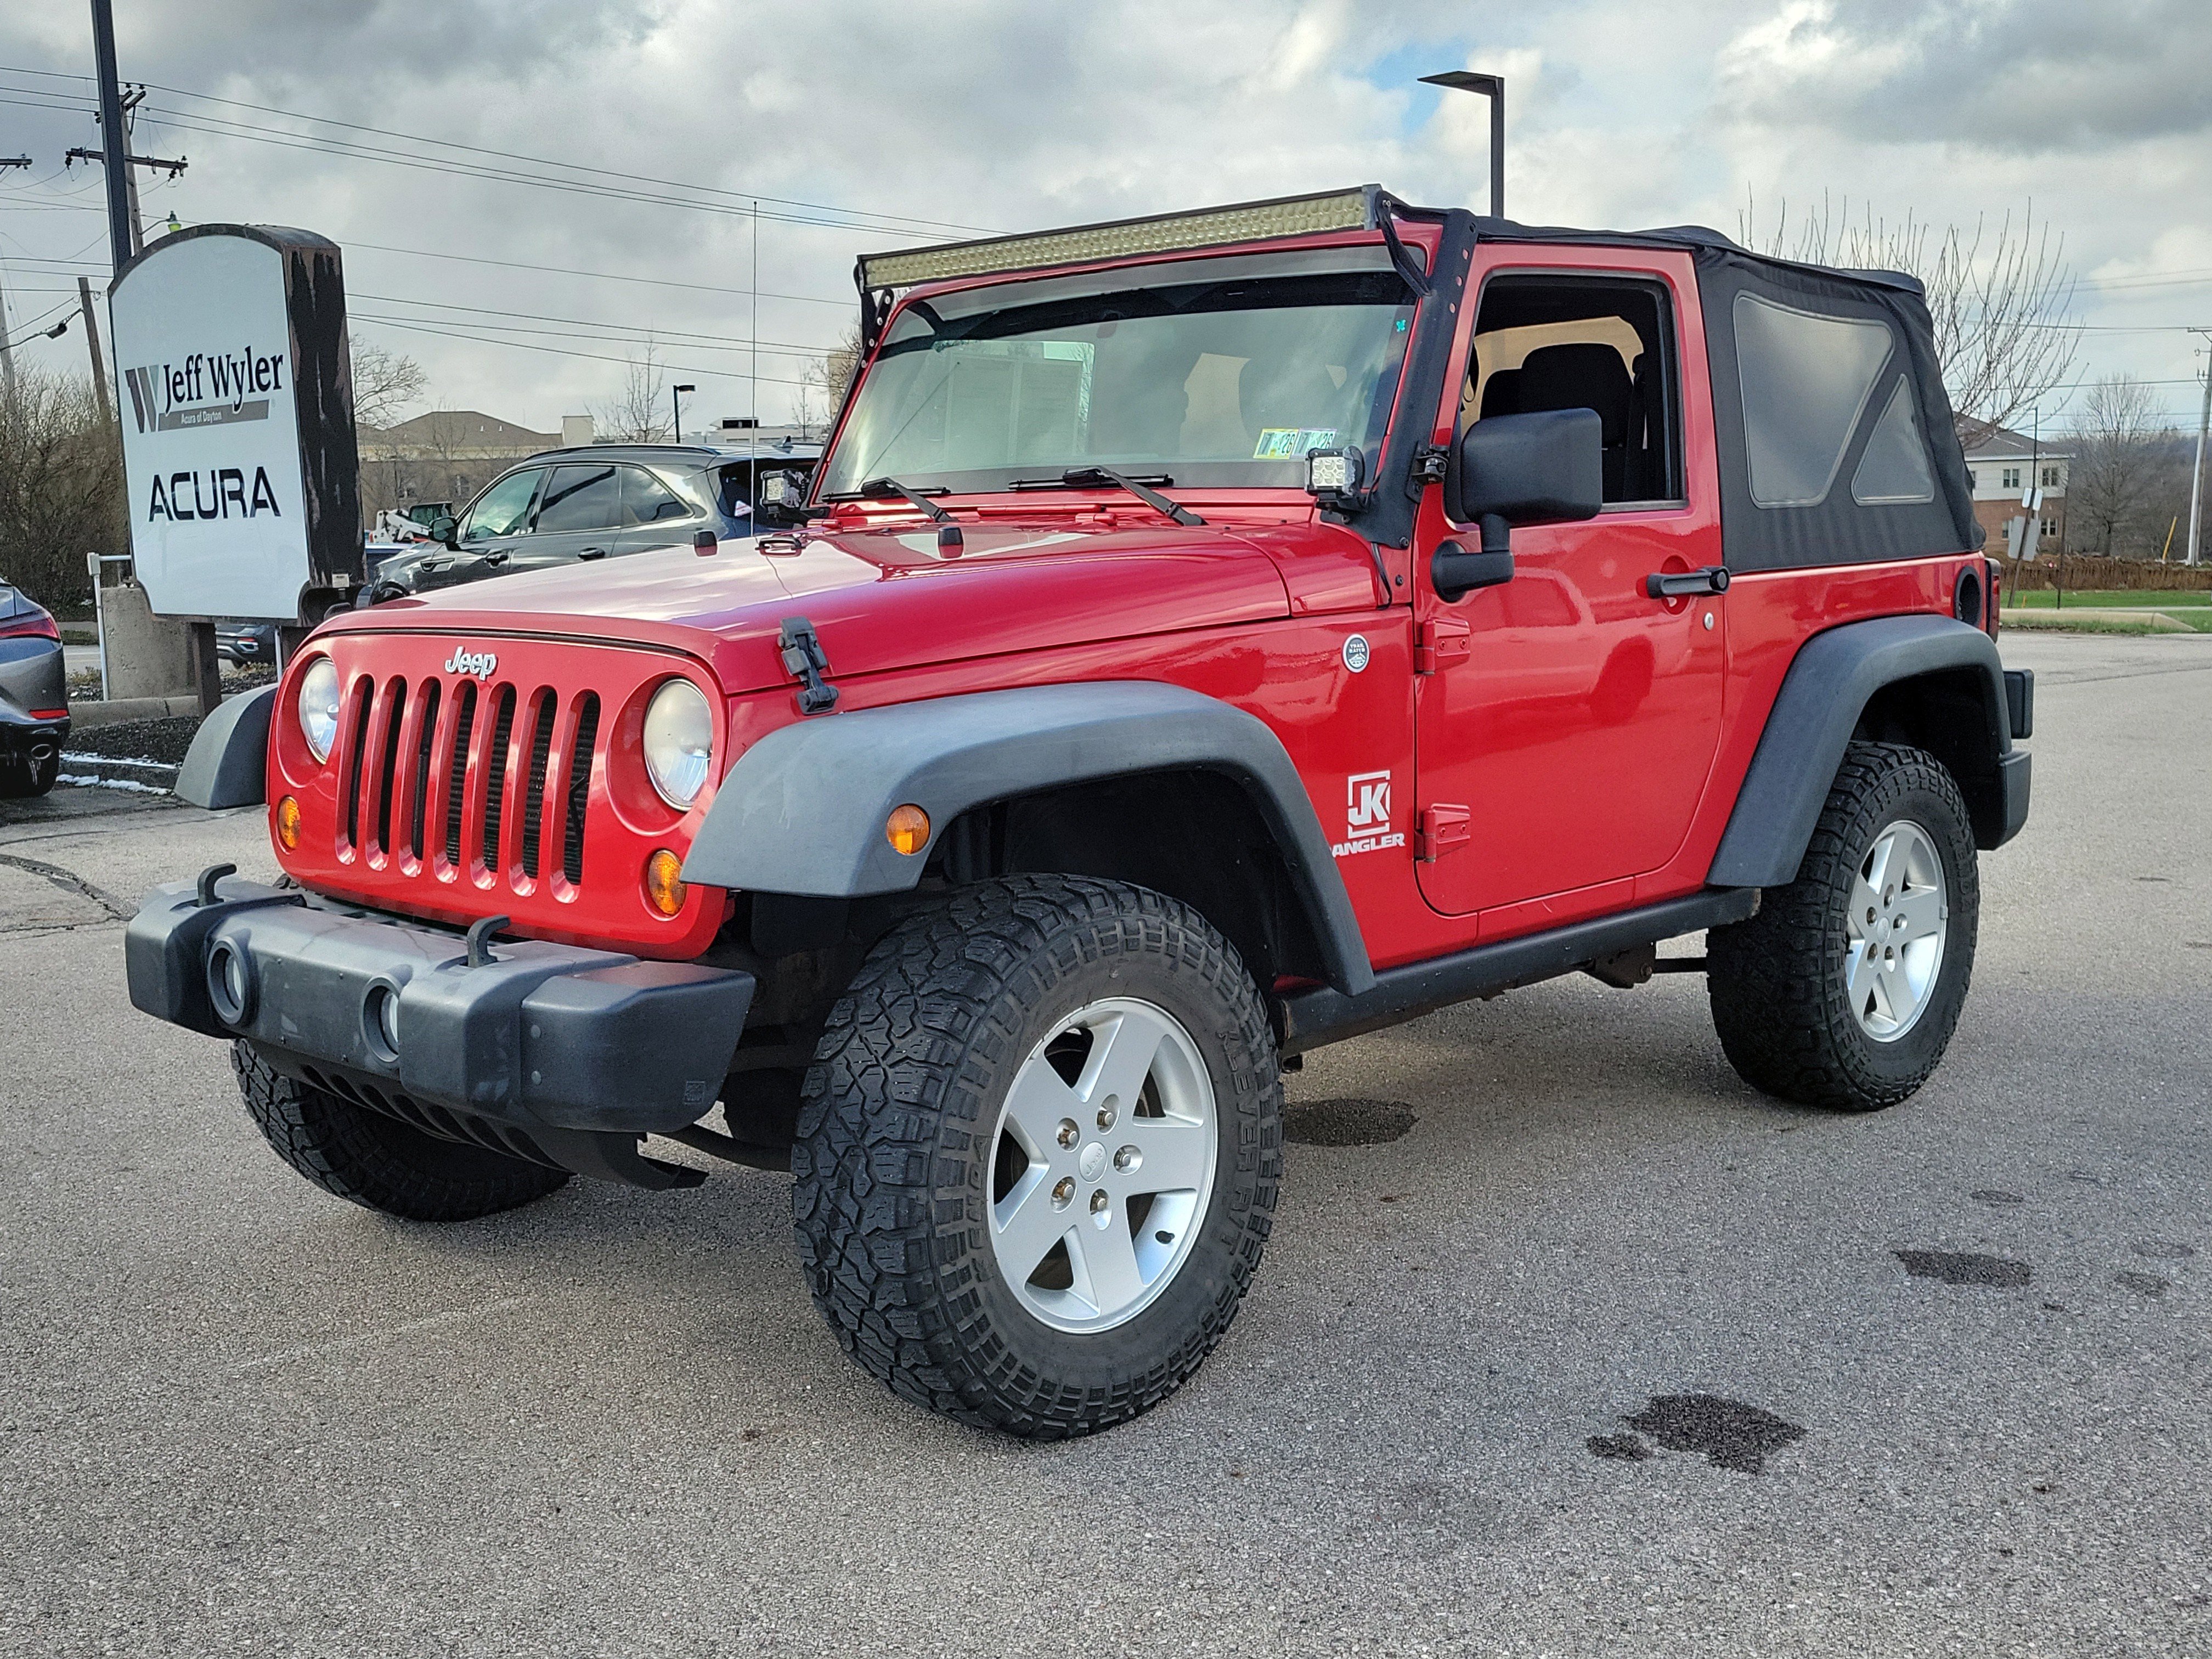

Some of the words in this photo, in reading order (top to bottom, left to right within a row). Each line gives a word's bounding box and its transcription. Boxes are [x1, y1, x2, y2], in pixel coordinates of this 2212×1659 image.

[163, 354, 202, 414] Jeff
[207, 346, 283, 412] Wyler
[1282, 433, 1295, 453] 26
[149, 466, 281, 522] ACURA
[445, 646, 497, 681] Jeep
[1348, 782, 1390, 826] JK
[1216, 1030, 1257, 1172] KLEVER
[1087, 1148, 1103, 1175] Jeep
